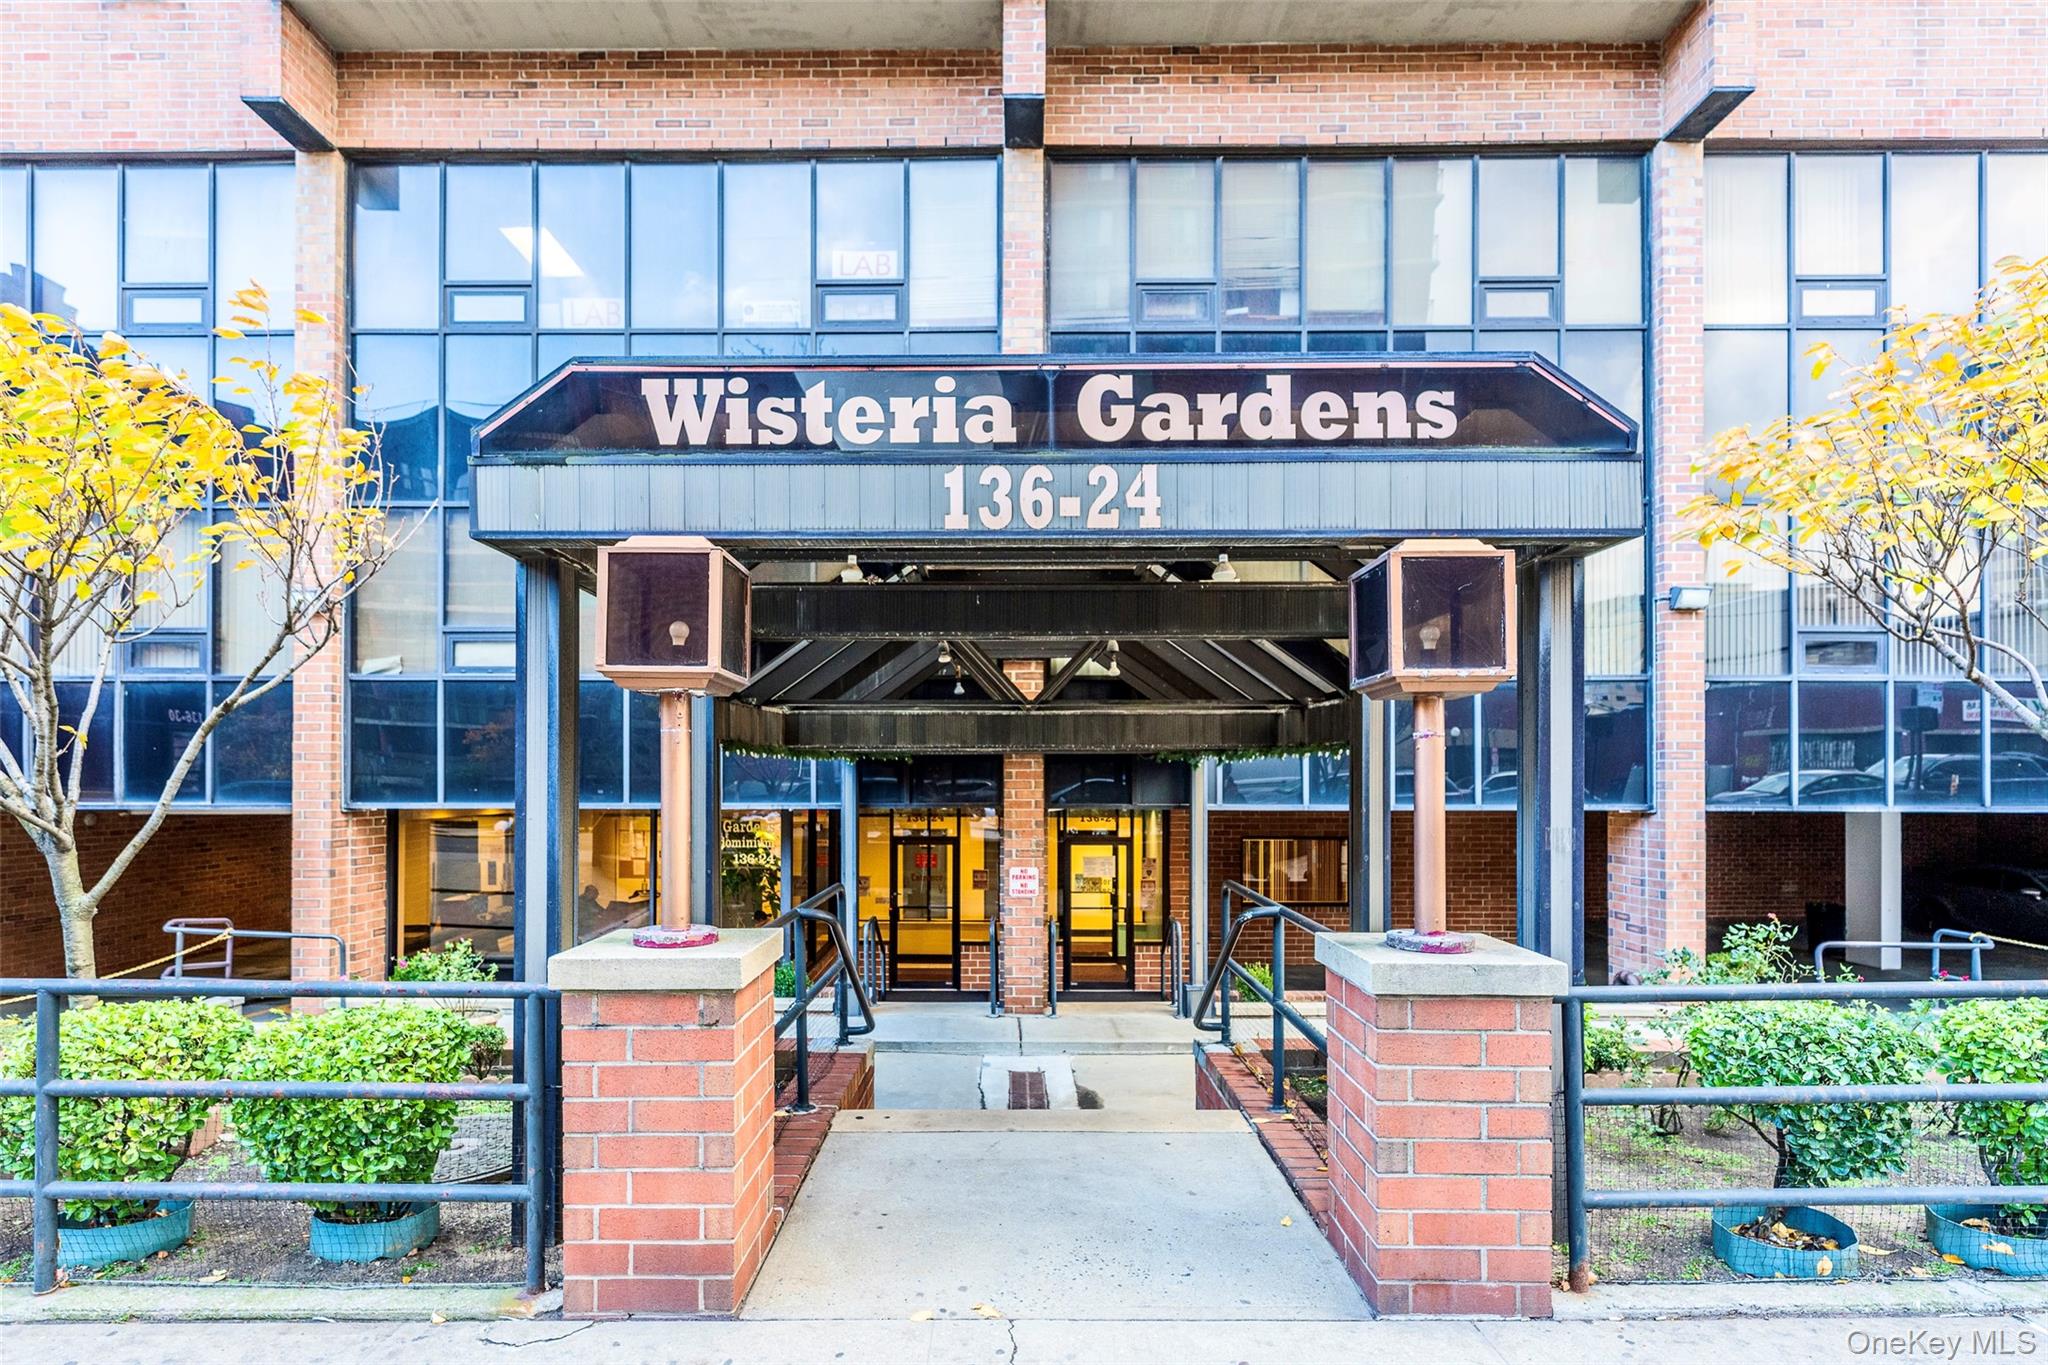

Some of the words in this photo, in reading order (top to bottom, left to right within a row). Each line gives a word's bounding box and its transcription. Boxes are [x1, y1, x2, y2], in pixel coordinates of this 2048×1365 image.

[839, 254, 892, 276] LAB
[570, 300, 621, 326] LAB
[641, 376, 1017, 446] Wisteria
[1077, 373, 1458, 442] Gardens
[943, 463, 1162, 530] 136-24
[722, 820, 776, 833] Gardes
[733, 853, 777, 866] 136-24
